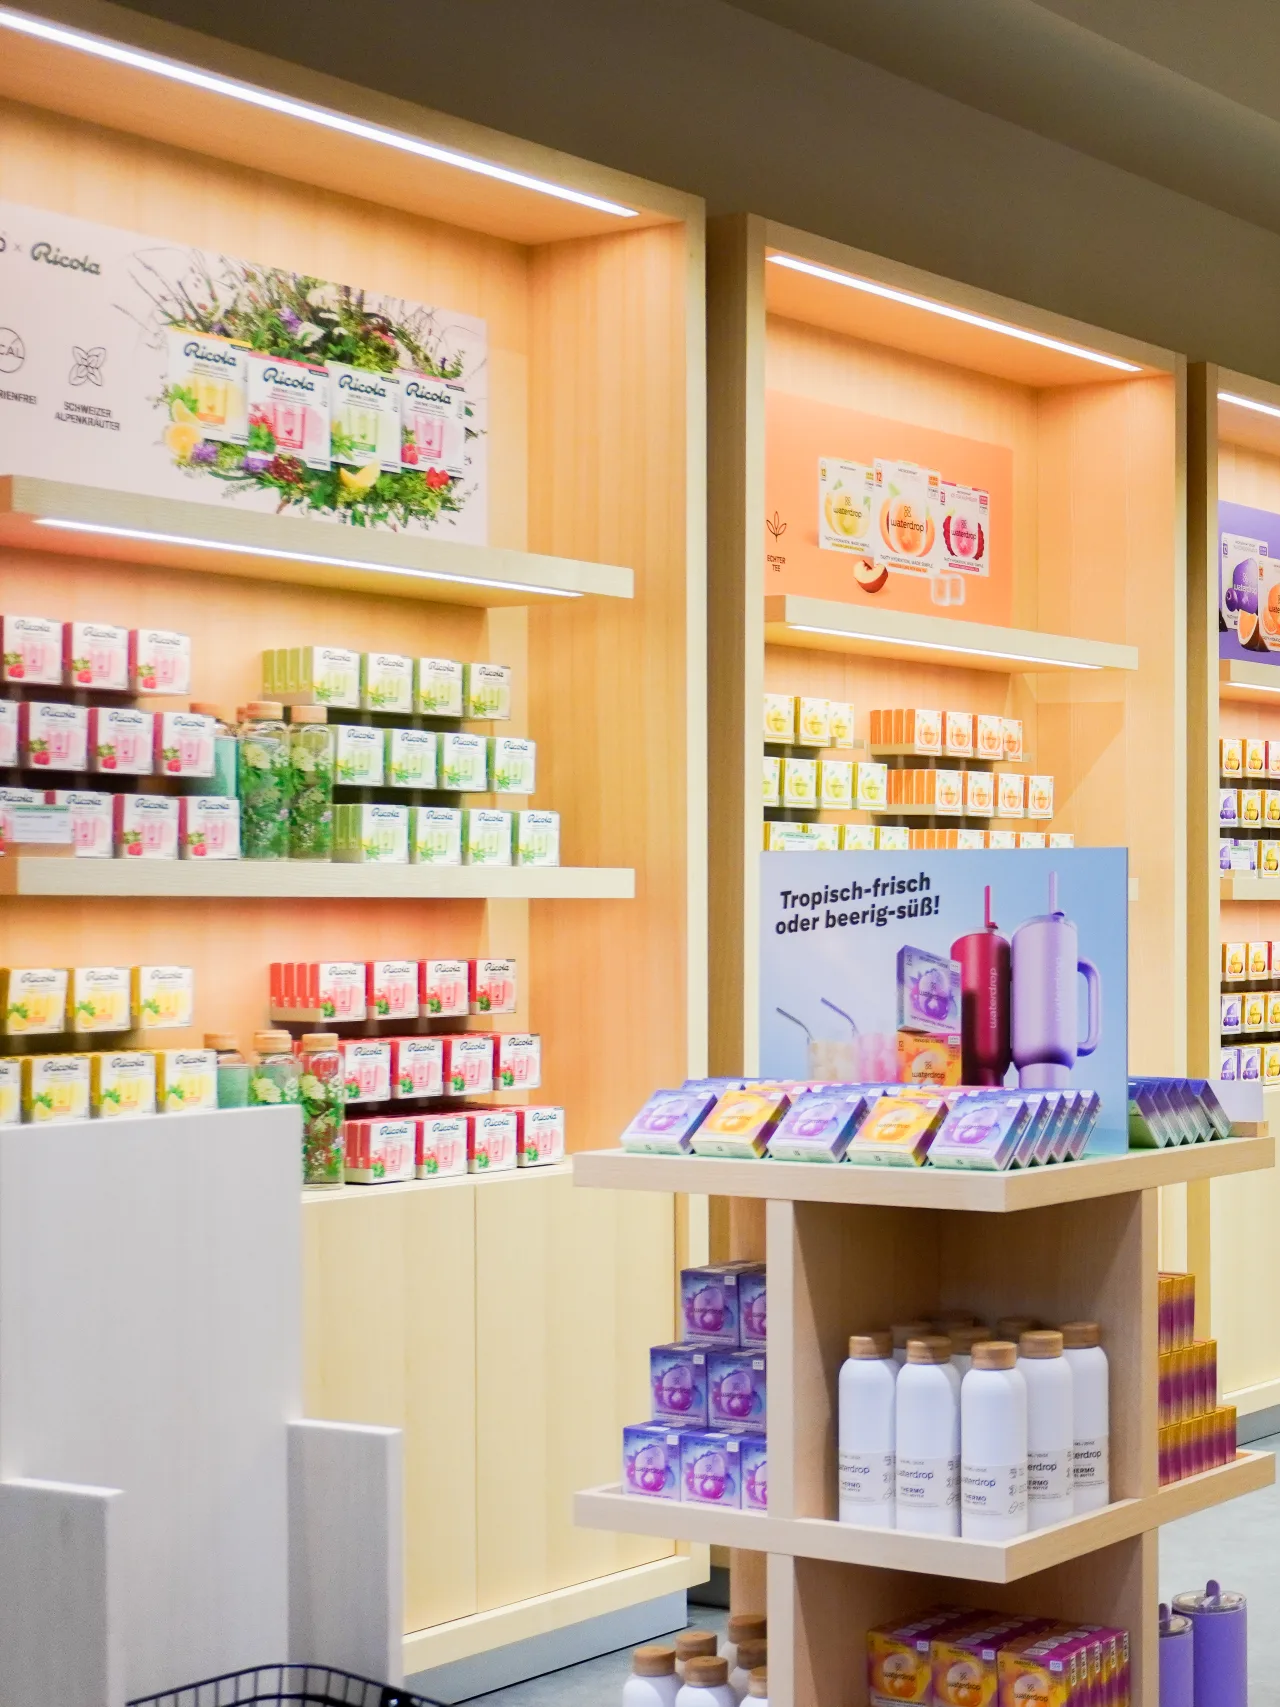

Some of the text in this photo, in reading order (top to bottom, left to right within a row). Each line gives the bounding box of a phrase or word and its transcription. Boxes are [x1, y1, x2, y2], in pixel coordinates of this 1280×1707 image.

[30, 242, 101, 275] Ricola
[184, 341, 237, 367] Ricola
[263, 367, 315, 391] Ricola
[338, 374, 387, 398] Ricola
[406, 382, 452, 405] Ricola
[54, 411, 121, 431] ALPENKRÄUTER
[63, 401, 112, 418] SCHWEIZER
[891, 519, 924, 533] waterdrop
[952, 530, 977, 540] waterdrop
[780, 871, 931, 912] Tropisch-frisch
[775, 895, 940, 934] oder beerig-süß!
[989, 967, 998, 1029] waterdrop
[912, 1070, 946, 1080] waterdrop
